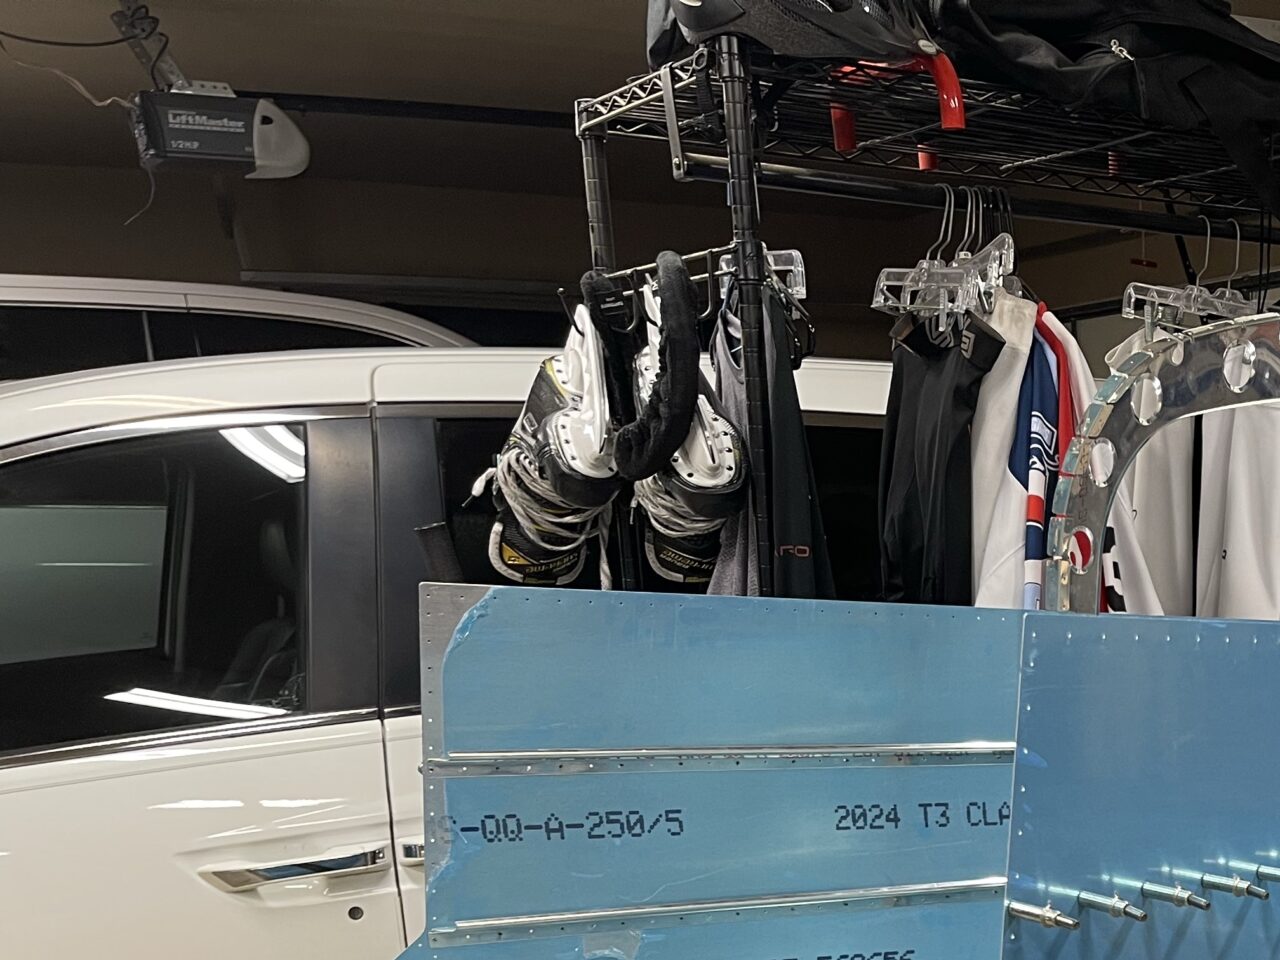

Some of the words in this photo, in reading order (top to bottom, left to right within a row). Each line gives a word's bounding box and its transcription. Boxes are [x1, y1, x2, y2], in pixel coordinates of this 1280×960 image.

[168, 113, 246, 128] LiftMaster
[834, 804, 901, 831] 2024
[917, 802, 950, 828] T3
